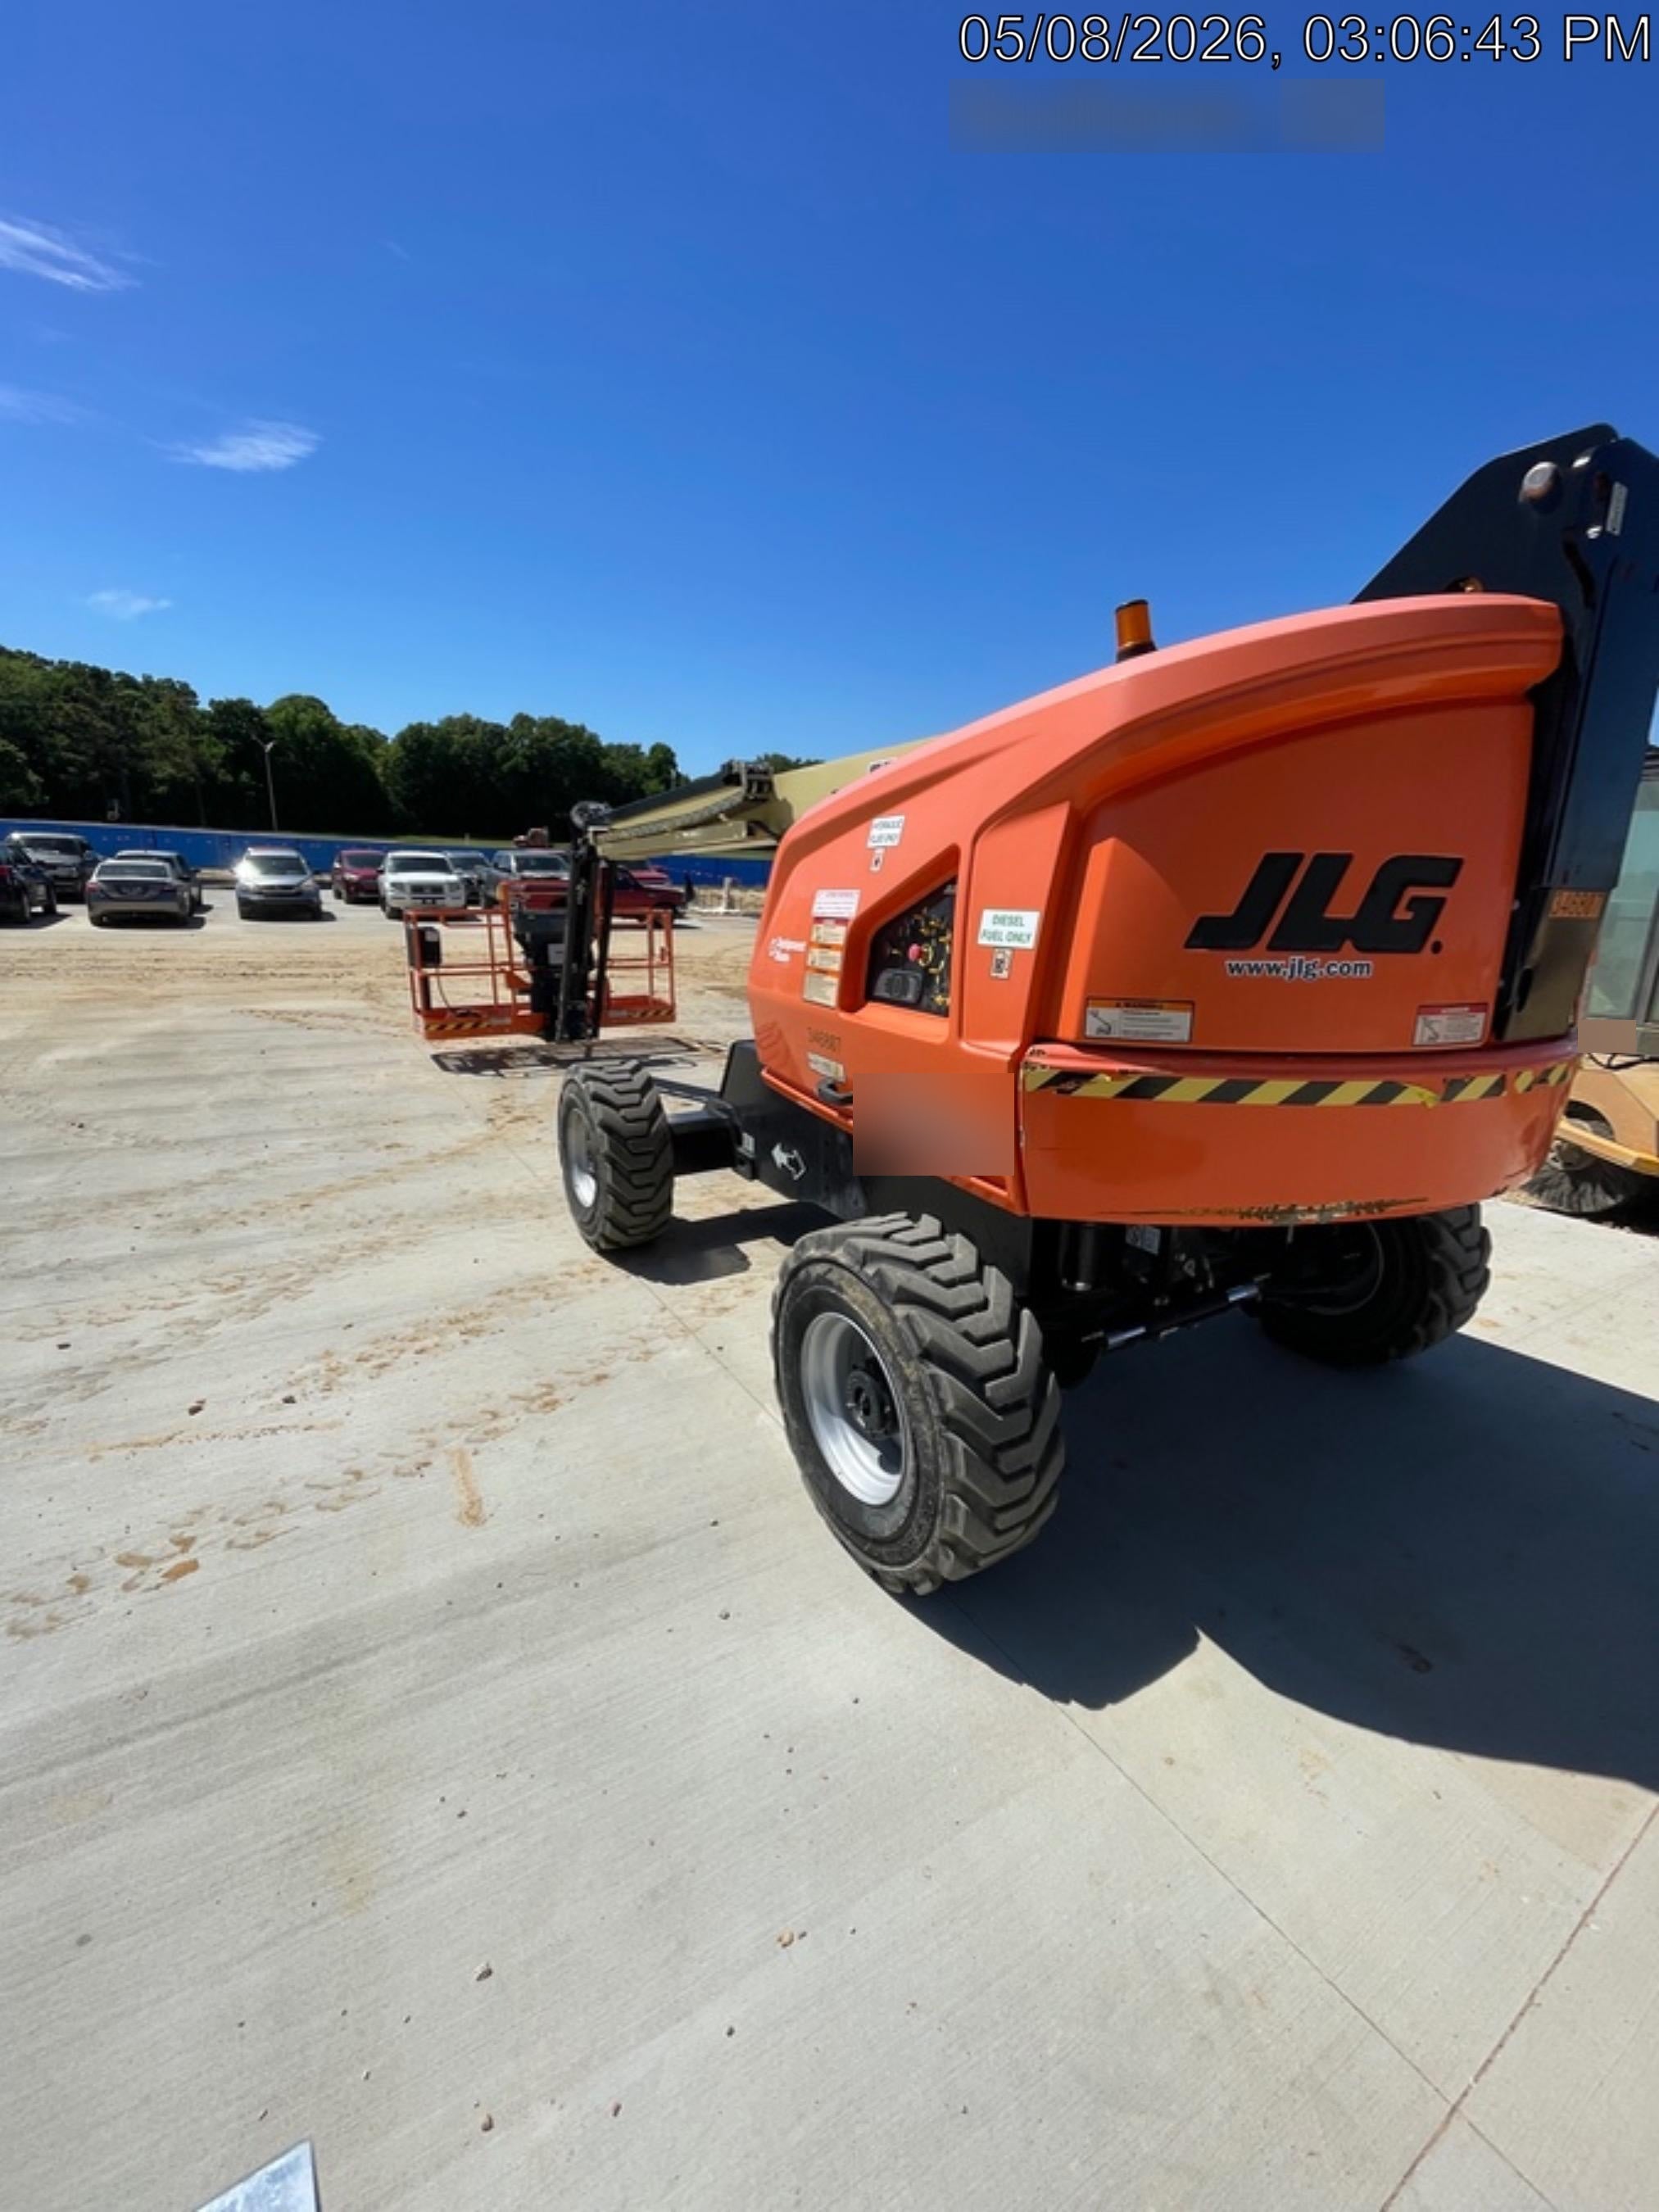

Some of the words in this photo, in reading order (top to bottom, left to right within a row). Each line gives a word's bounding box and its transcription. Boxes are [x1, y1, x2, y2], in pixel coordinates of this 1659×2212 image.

[992, 913, 1025, 927] DIESEL
[981, 928, 1004, 942] FUEL
[1005, 931, 1031, 944] ONLY
[1226, 958, 1372, 978] www.jlg.com
